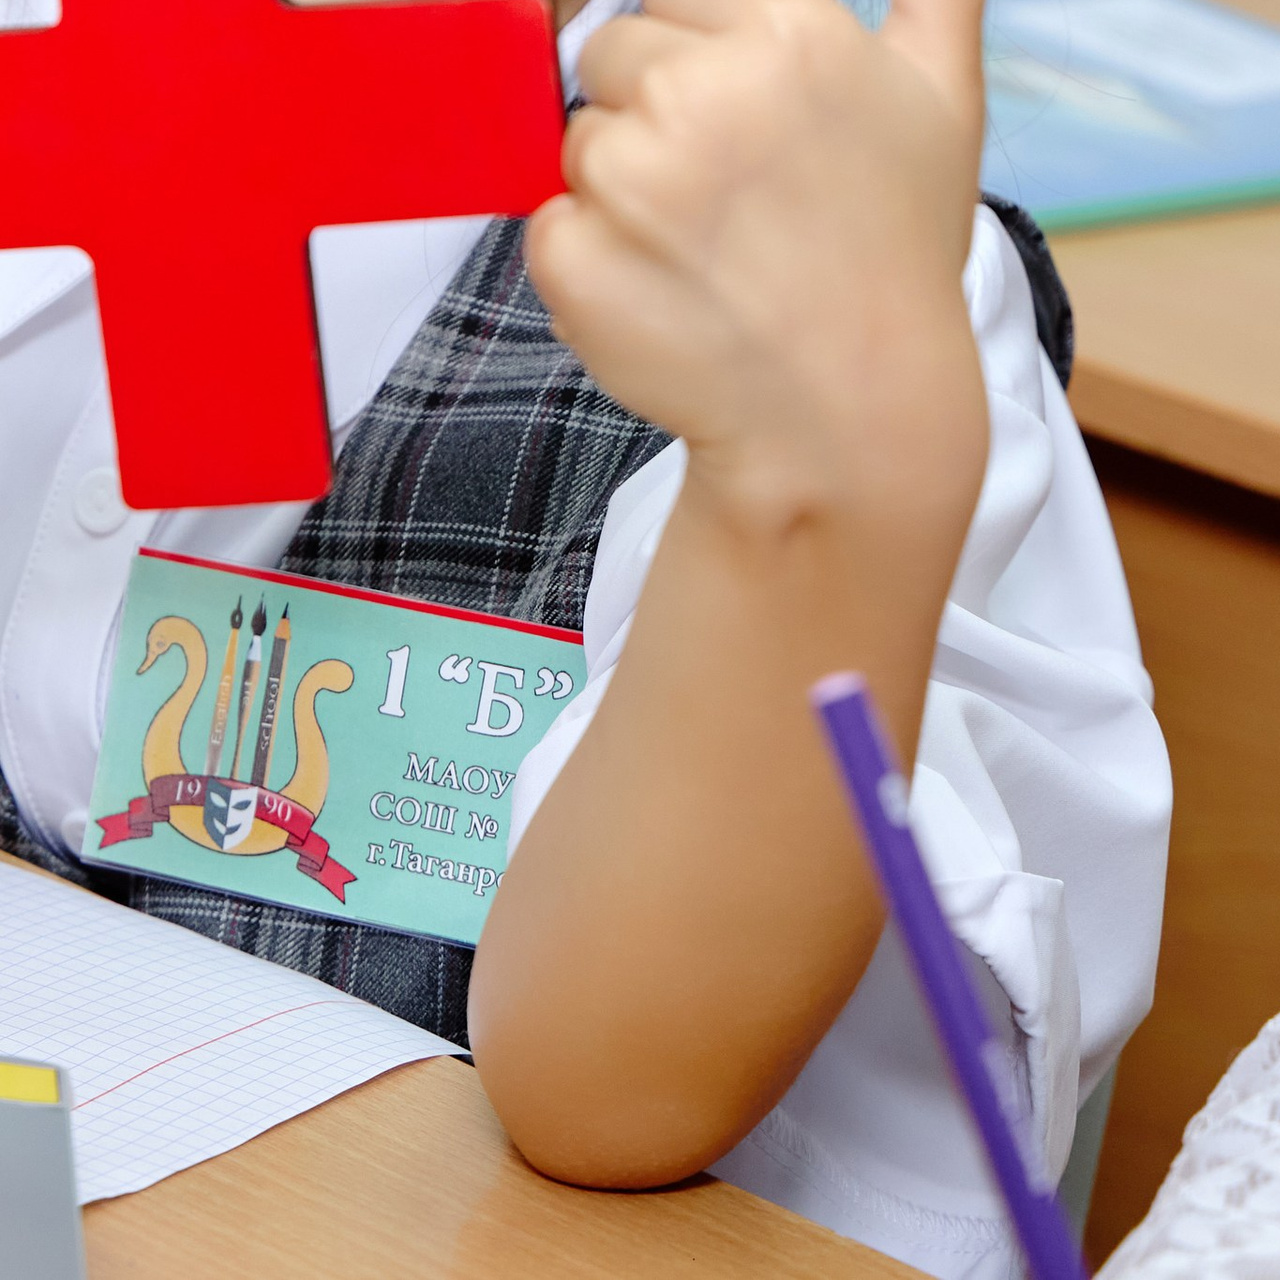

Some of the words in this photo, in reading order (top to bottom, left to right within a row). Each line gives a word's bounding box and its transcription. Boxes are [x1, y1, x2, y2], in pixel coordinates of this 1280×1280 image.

[377, 644, 411, 719] 1
[260, 676, 280, 751] school
[176, 779, 202, 802] 19
[264, 794, 292, 822] 90
[403, 751, 517, 800] МАОУ
[369, 791, 459, 836] СОШ
[464, 811, 499, 842] №
